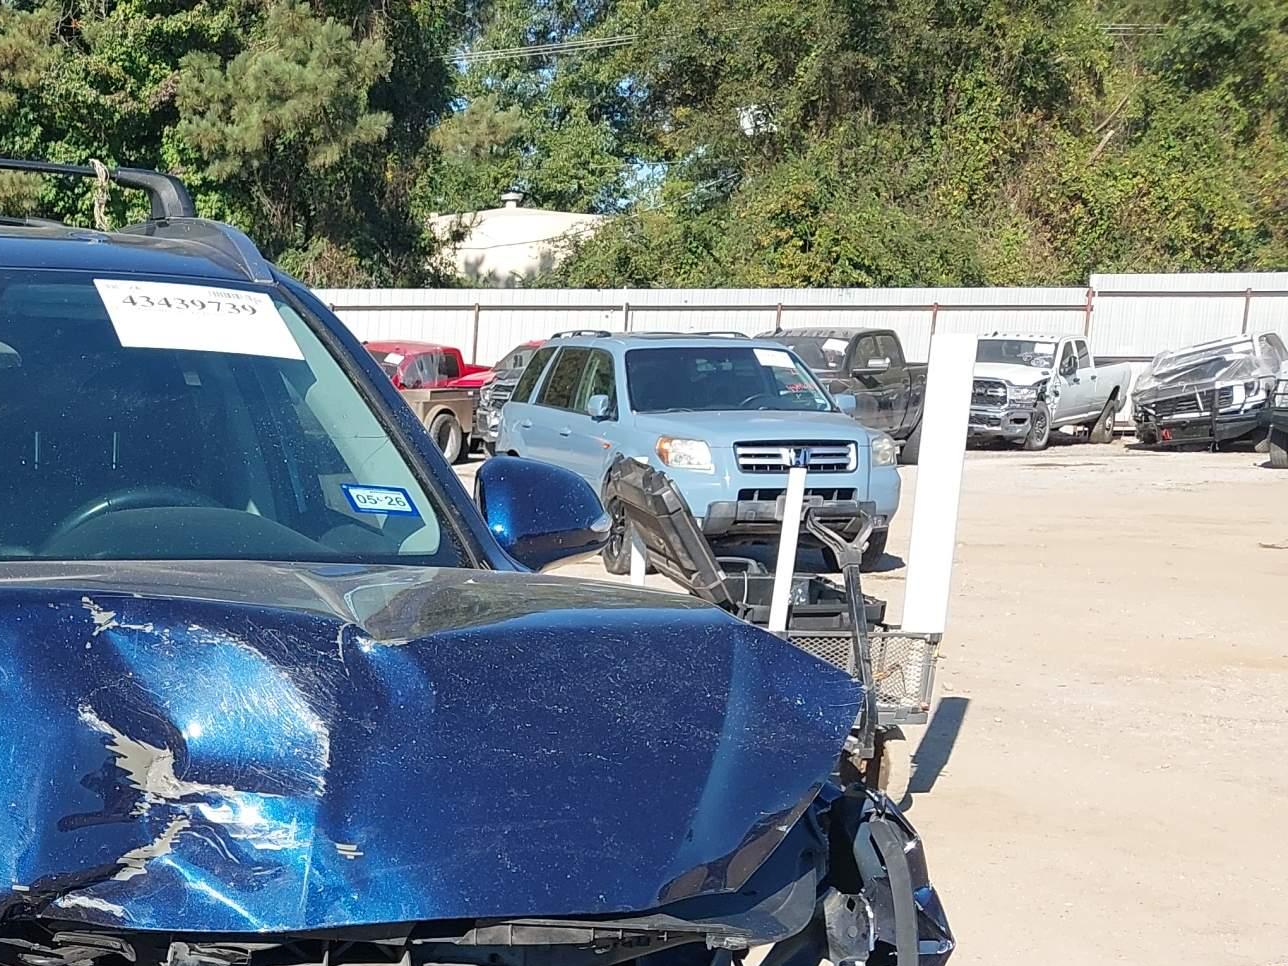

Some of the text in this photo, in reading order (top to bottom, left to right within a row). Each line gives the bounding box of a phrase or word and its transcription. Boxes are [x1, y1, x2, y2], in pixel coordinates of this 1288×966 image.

[121, 294, 258, 316] 43439739
[355, 494, 407, 507] 05 26
